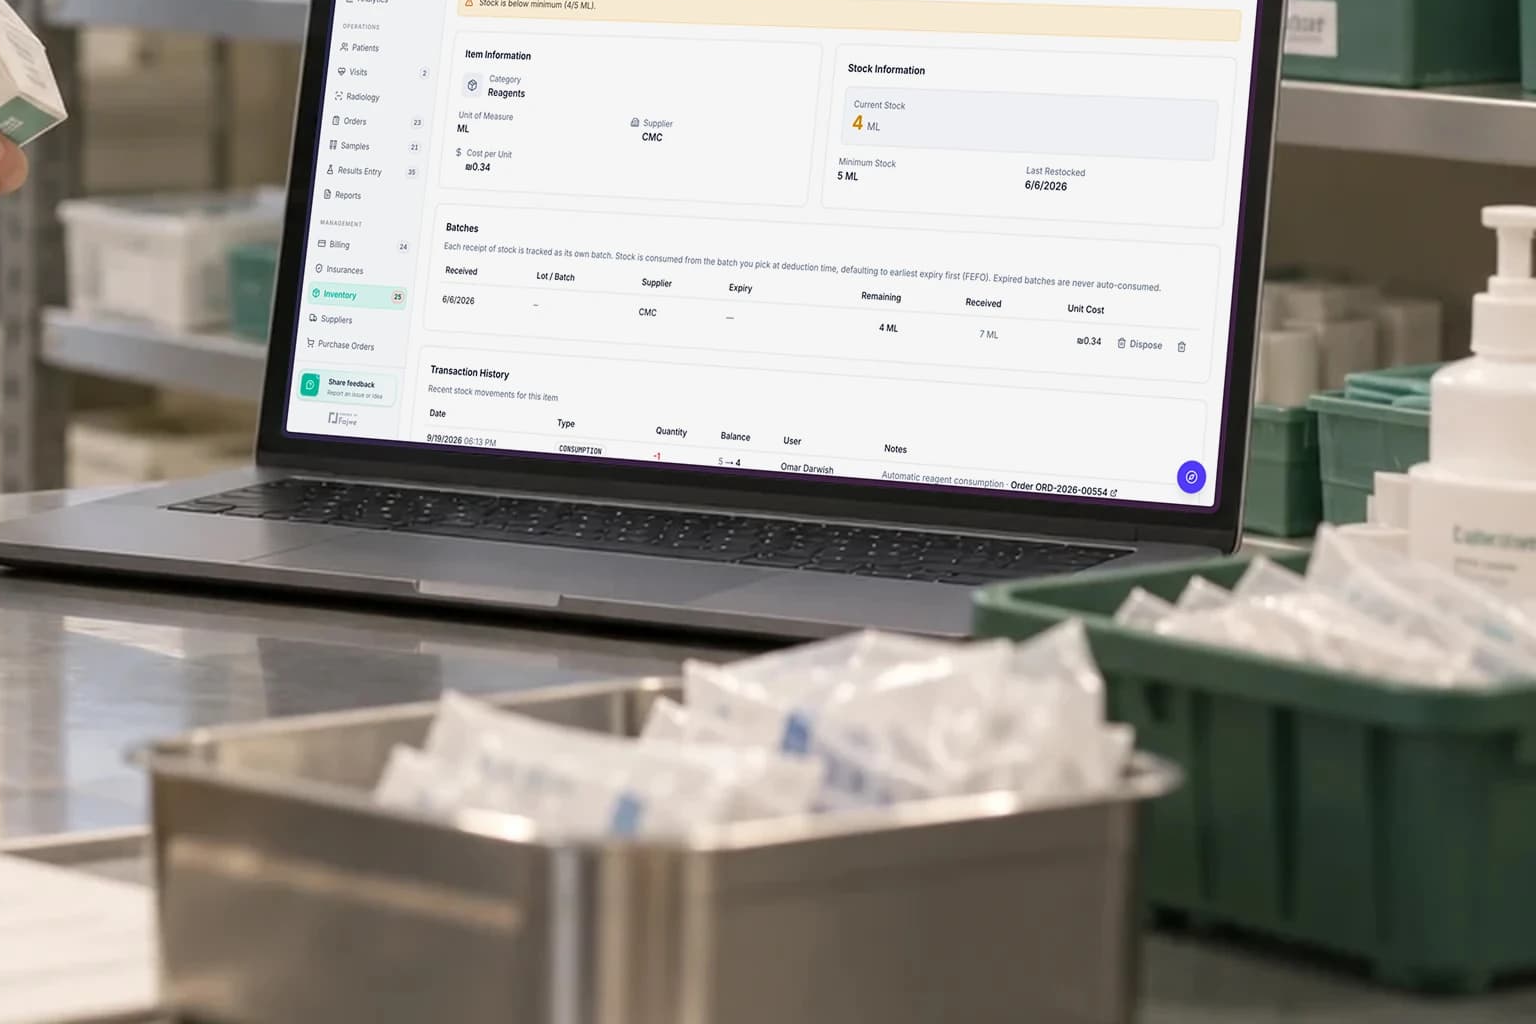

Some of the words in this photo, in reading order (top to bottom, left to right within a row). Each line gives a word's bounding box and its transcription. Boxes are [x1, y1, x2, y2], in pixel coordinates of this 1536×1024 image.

[500, 0, 506, 7] is
[507, 0, 529, 7] below
[530, 0, 562, 8] minimum
[563, 0, 579, 9] (4/5
[579, 1, 596, 10] ML).
[351, 43, 379, 52] Patients
[464, 49, 483, 59] Item
[484, 49, 531, 61] Information
[349, 67, 367, 76] Visits
[847, 63, 873, 73] Stock
[874, 63, 925, 75] Information
[489, 74, 521, 85] Category
[346, 92, 380, 103] Radiology
[487, 87, 525, 99] Reagents
[853, 99, 882, 109] Current
[883, 100, 905, 110] Stock
[343, 116, 367, 125] Orders
[458, 111, 473, 119] Unit
[473, 111, 482, 119] of
[482, 111, 513, 121] Measure
[642, 118, 673, 128] Supplier
[852, 114, 863, 130] 4
[866, 121, 880, 131] ML
[456, 123, 469, 133] ML
[641, 131, 663, 142] CMC
[340, 141, 370, 151] Samples
[466, 148, 483, 157] Cost
[497, 150, 512, 158] Unit
[838, 157, 873, 167] Minimum
[874, 158, 896, 168] Stock
[337, 165, 362, 175] Results
[363, 167, 382, 177] Entry
[836, 170, 843, 180] 5
[844, 171, 859, 181] ML
[1025, 166, 1043, 174] Last
[1044, 166, 1086, 177] Restocked
[1024, 179, 1067, 191] 6/6/2026
[334, 190, 361, 200] Reports
[445, 222, 479, 233] Batches
[329, 239, 350, 251] Billing
[326, 265, 364, 274] Insurances
[443, 241, 461, 250] Each
[462, 243, 487, 253] receipt
[488, 244, 496, 252] of
[497, 245, 517, 253] stock
[517, 246, 524, 254] is
[525, 247, 552, 256] tracked
[563, 248, 572, 257] its
[574, 250, 589, 258] own
[590, 250, 613, 259] batch.
[615, 251, 636, 260] Stock
[636, 253, 643, 261] is
[644, 255, 683, 263] consumed
[684, 255, 702, 264] from
[703, 257, 715, 266] the
[716, 258, 738, 266] batch
[739, 260, 753, 269] you
[754, 260, 770, 269] pick
[781, 261, 819, 271] deduction
[820, 263, 838, 274] time,
[840, 265, 878, 277] defaulting
[880, 267, 888, 276] to
[889, 268, 917, 278] earliest
[919, 271, 943, 280] expiry
[945, 270, 960, 280] first
[962, 271, 991, 282] (FEFO).
[992, 273, 1022, 284] Expired
[1024, 275, 1055, 285] batches
[1071, 280, 1094, 288] never
[1096, 281, 1161, 292] auto-consumed.
[444, 265, 478, 276] Received
[536, 271, 548, 280] Lot
[553, 272, 575, 282] Batch
[641, 277, 672, 288] Supplier
[728, 282, 752, 294] Expiry
[323, 289, 356, 301] Inventory
[441, 295, 475, 305] 6/6/2026
[861, 290, 901, 304] Remaining
[965, 297, 1002, 308] Received
[638, 307, 657, 317] CMC
[1067, 303, 1084, 313] Unit
[1085, 304, 1104, 315] Cost
[320, 314, 352, 324] Suppliers
[885, 323, 898, 333] ML
[986, 330, 998, 339] ML
[317, 339, 350, 349] Purchase
[350, 341, 374, 351] Orders
[1129, 339, 1163, 350] Dispose
[430, 364, 478, 376] Transaction
[479, 368, 510, 381] History
[328, 377, 346, 386] Share
[346, 379, 375, 388] feedback
[427, 384, 452, 394] Recent
[453, 387, 472, 395] stock
[474, 389, 515, 399] movements
[516, 390, 527, 399] for
[528, 392, 541, 400] this
[542, 392, 558, 401] item
[429, 408, 446, 418] Date
[556, 418, 575, 429] Type
[655, 426, 688, 438] Quantity
[720, 431, 751, 442] Balance
[426, 433, 462, 444] 9/19/2026
[463, 436, 483, 445] 06:13
[484, 438, 496, 446] PM
[783, 435, 802, 445] User
[883, 443, 907, 454] Notes
[780, 462, 801, 471] Omar
[802, 463, 834, 474] Darwish
[881, 470, 920, 481] Automatic
[922, 475, 952, 484] reagent
[953, 477, 1004, 488] consumption
[1010, 480, 1033, 490] Order
[1035, 482, 1107, 496] ORD-2026-00554
